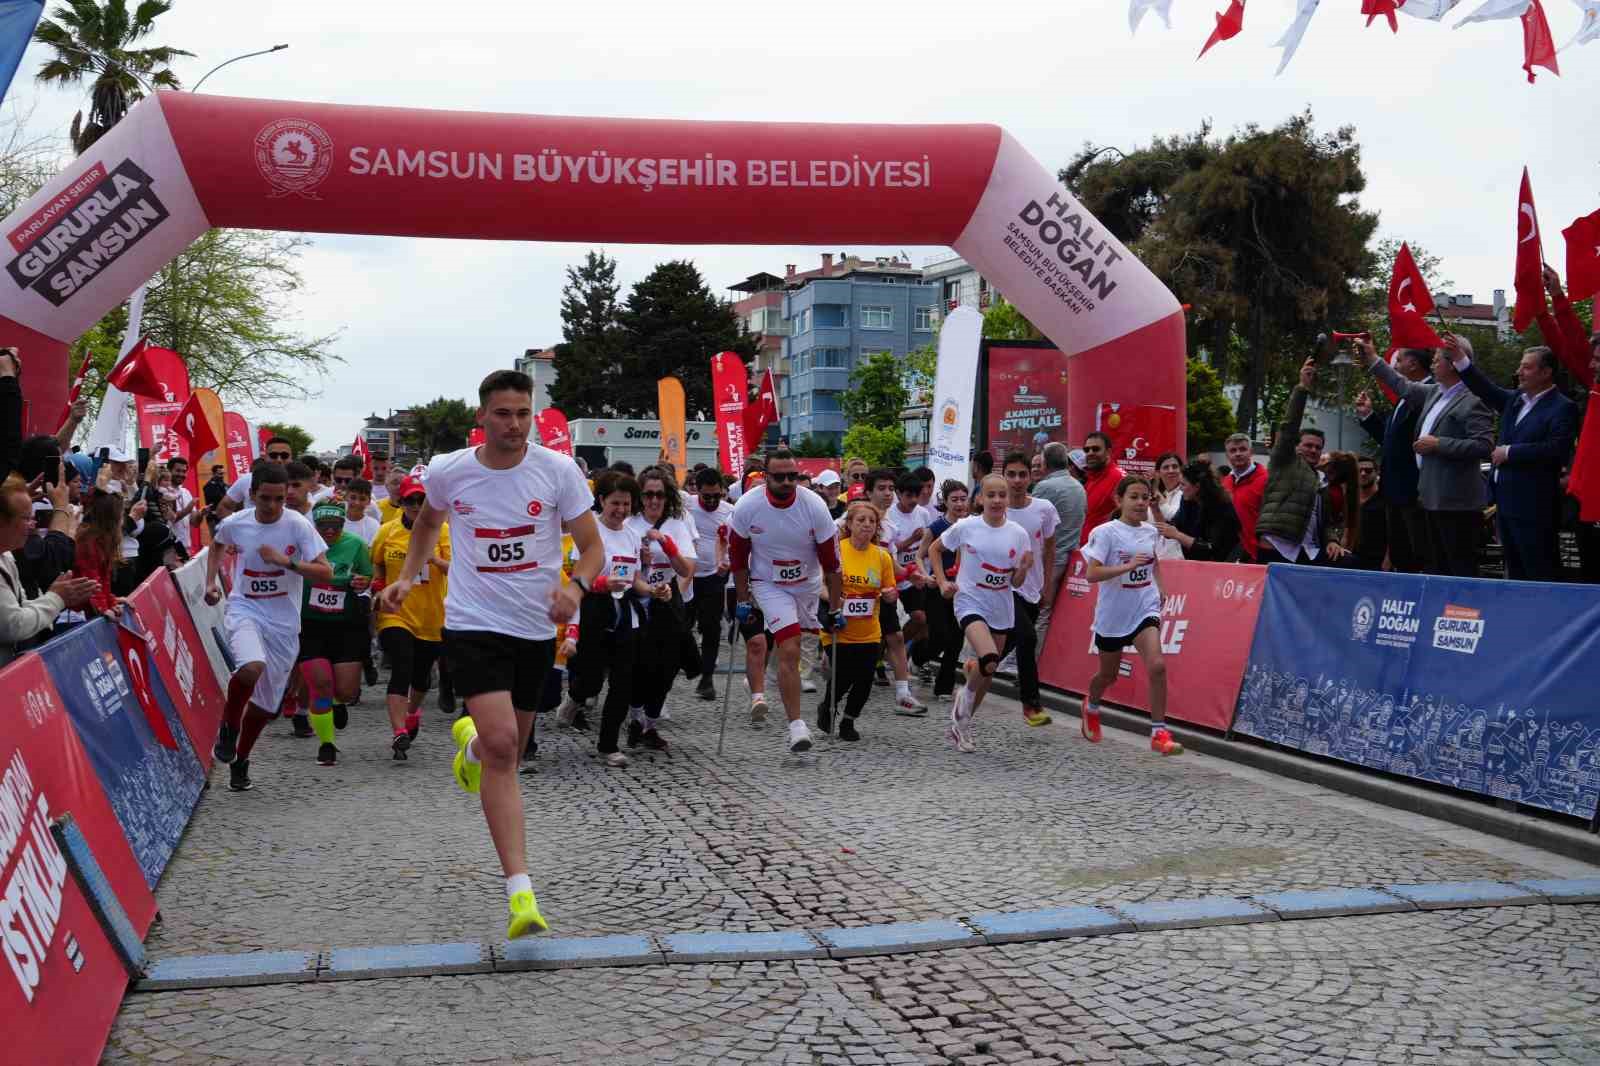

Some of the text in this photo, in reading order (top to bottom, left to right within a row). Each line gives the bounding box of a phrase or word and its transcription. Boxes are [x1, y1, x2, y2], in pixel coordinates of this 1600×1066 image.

[349, 146, 931, 192] SAMSUN BÜYÜKŞEHİR BELEDİYESİ
[17, 168, 101, 244] PARLAYAN ŞEHİR
[17, 172, 141, 279] GURURLA
[1046, 191, 1123, 268] HALİT
[50, 200, 159, 299] SAMSUN
[1007, 222, 1044, 260] SAMSUN
[1018, 199, 1118, 301] DOĞAN
[624, 426, 660, 440] Sana
[488, 542, 525, 563] 055
[780, 567, 801, 580] 055
[985, 574, 1006, 585] 055
[1129, 568, 1148, 582] 055
[250, 580, 278, 593] 055
[317, 592, 338, 606] 055
[848, 602, 869, 613] 055
[1381, 599, 1416, 616] HALİT
[1378, 616, 1420, 633] DOĞAN
[1438, 619, 1480, 635] GURURLA
[1436, 635, 1476, 650] SAMSUN
